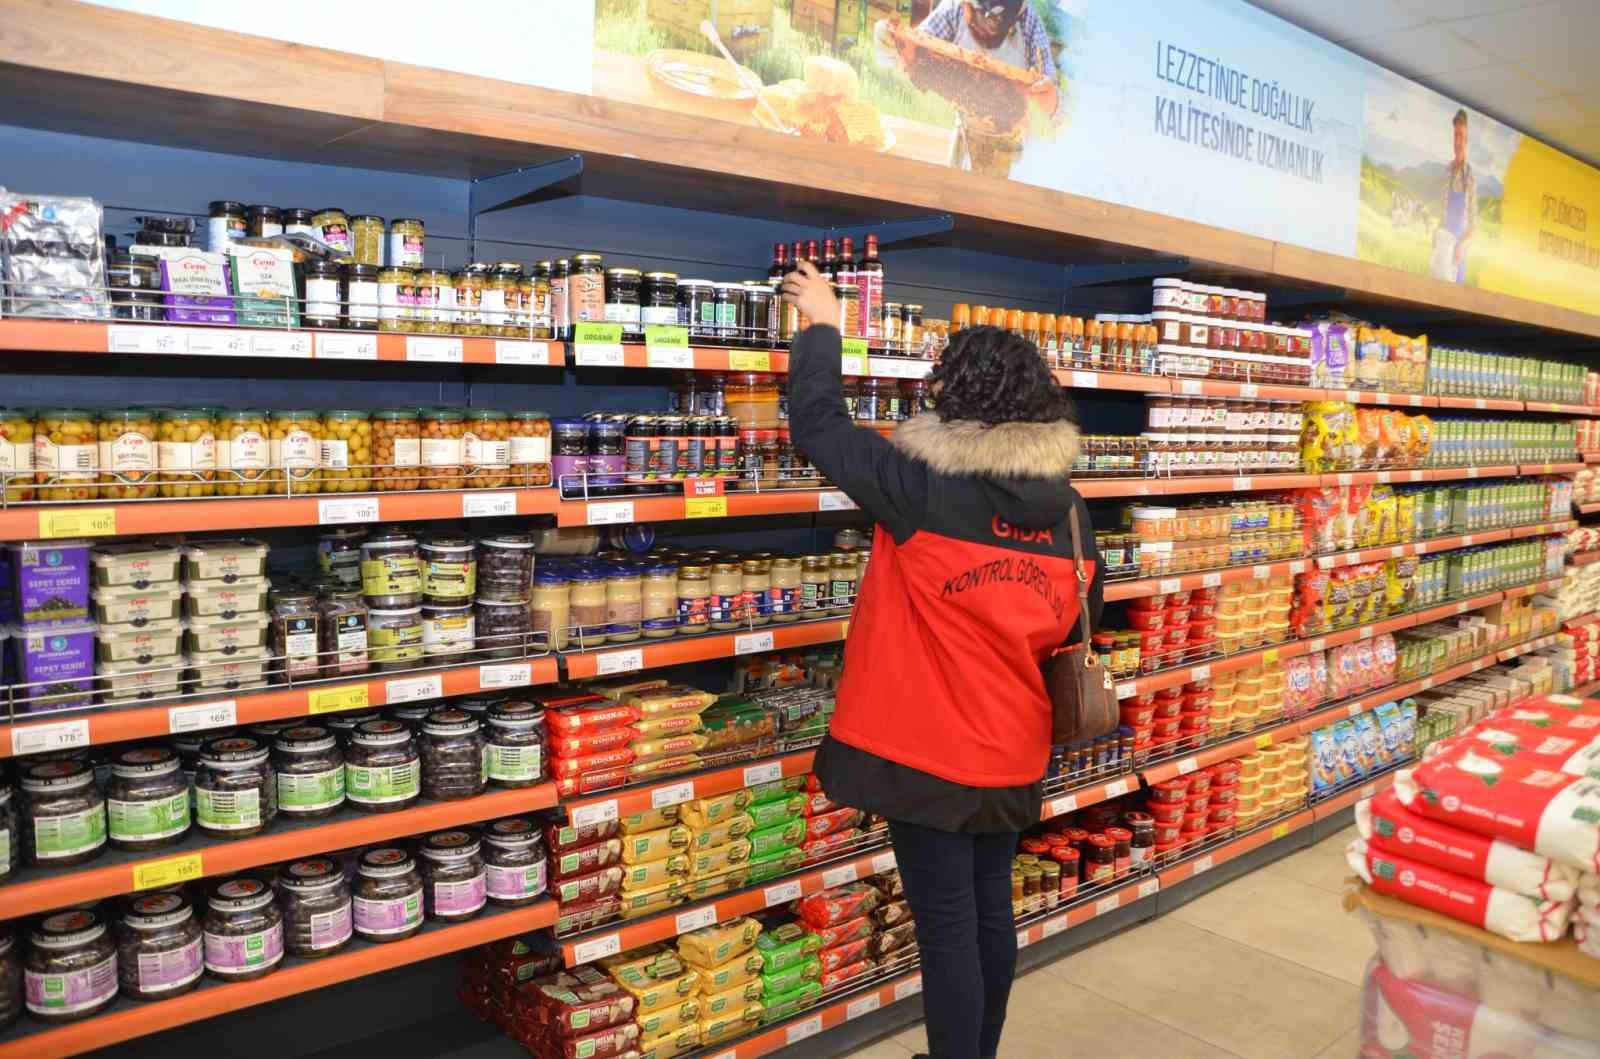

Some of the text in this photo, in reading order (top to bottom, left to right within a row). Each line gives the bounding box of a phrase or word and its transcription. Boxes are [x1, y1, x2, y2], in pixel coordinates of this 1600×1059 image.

[1156, 41, 1315, 134] LEZZETİNDE DOĞALLIK
[1155, 95, 1325, 184] KALİTESİNDE UZMANLIK
[940, 557, 1014, 599] KONTROL
